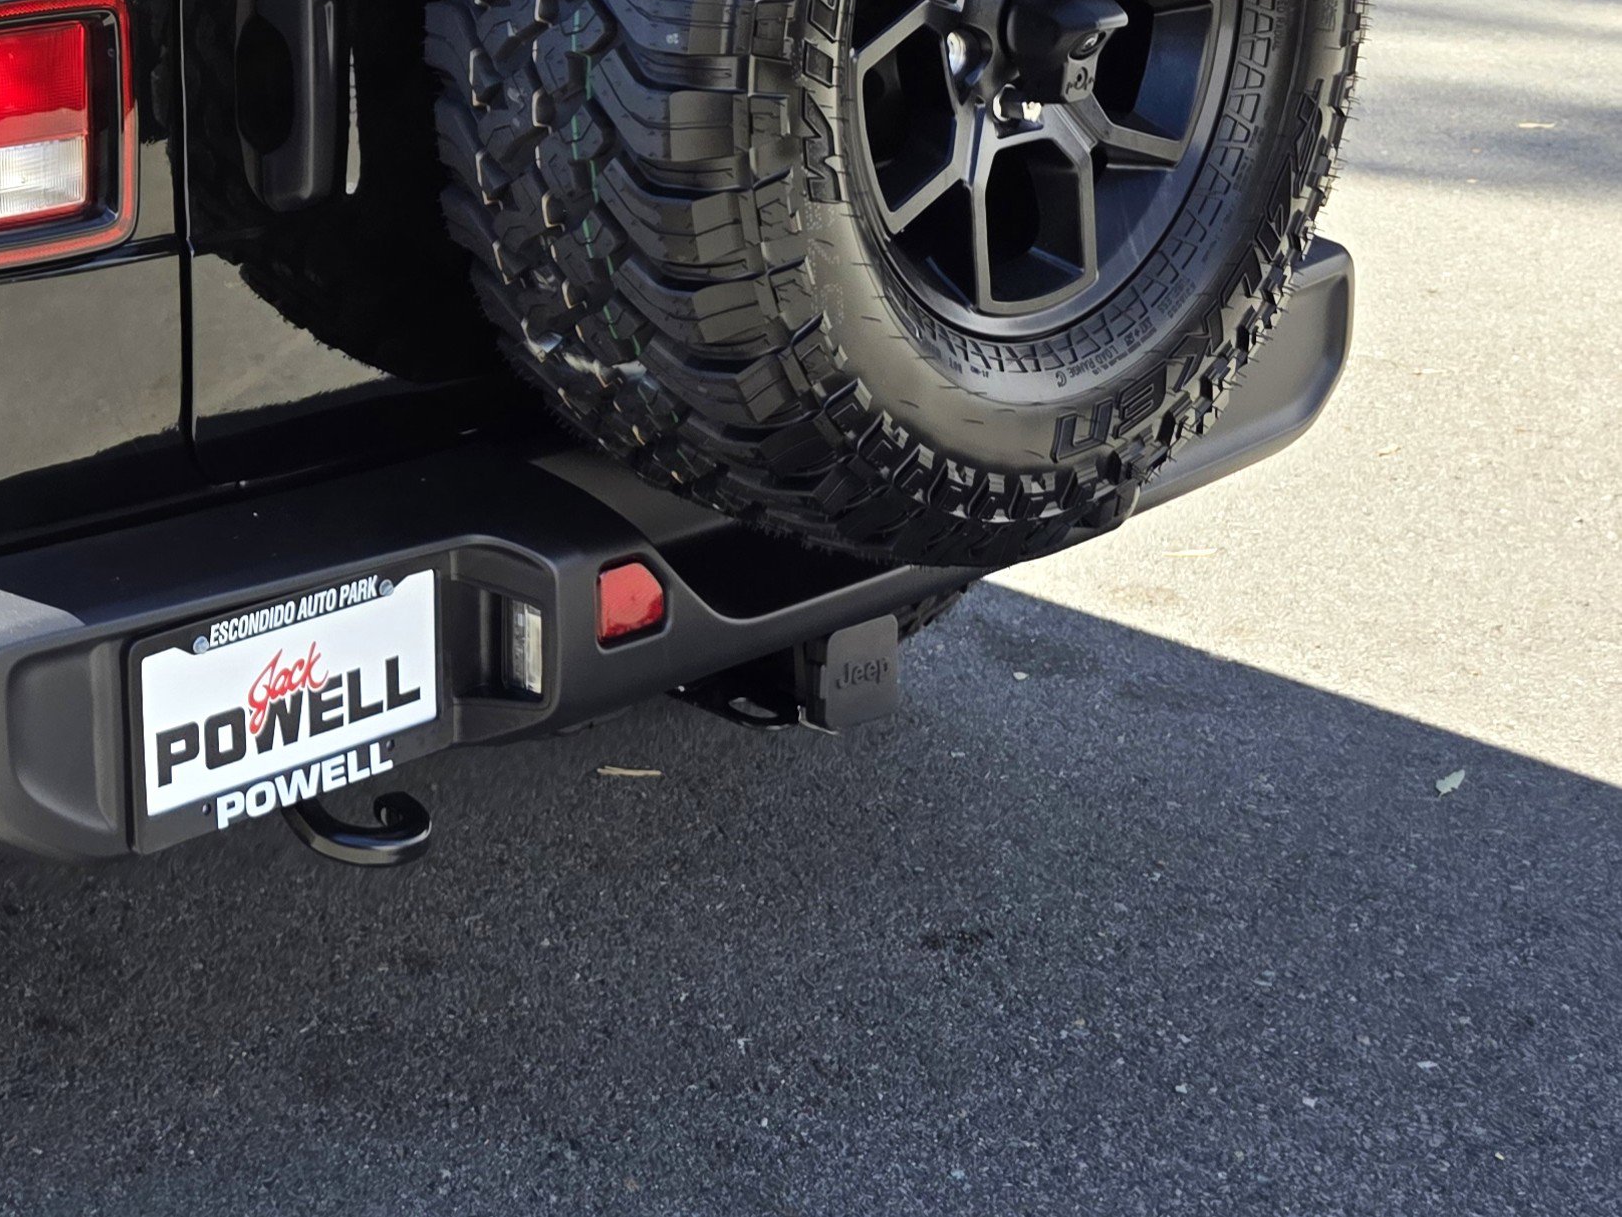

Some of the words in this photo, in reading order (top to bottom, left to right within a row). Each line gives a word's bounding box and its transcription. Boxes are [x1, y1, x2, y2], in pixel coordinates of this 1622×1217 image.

[209, 600, 295, 647] ESCONDIDO
[297, 587, 336, 620] AUTO
[338, 574, 378, 608] PARK
[247, 640, 329, 735] Jack
[836, 657, 889, 689] Jeep
[156, 655, 421, 788] POWELL
[216, 742, 394, 830] POWELL
